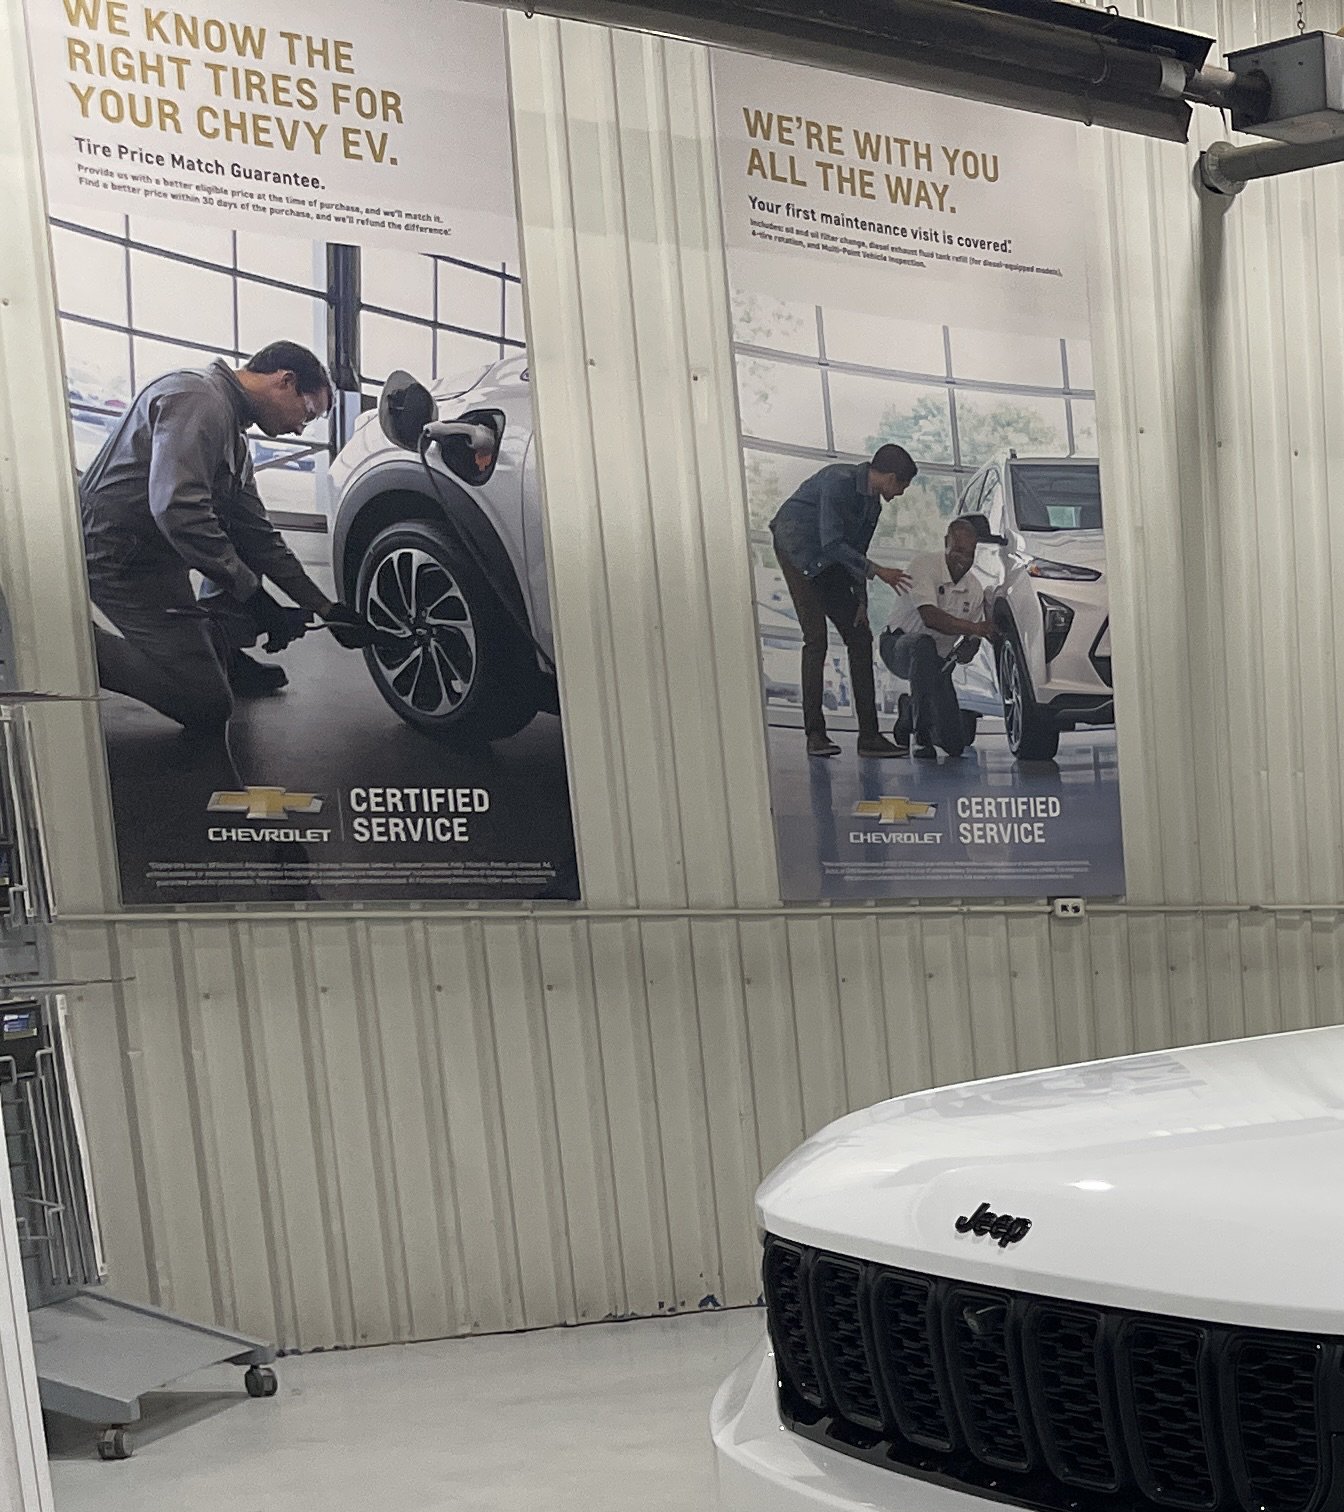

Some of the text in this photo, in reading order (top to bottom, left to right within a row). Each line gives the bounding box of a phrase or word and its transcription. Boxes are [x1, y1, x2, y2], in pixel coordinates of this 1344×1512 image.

[62, 0, 355, 74] WE KNOW THE
[67, 37, 404, 124] RIGHT TIRES FOR
[68, 81, 398, 166] YOUR CHEVY EV.
[742, 106, 1000, 183] WE'RE WITH YOU
[74, 136, 326, 190] Tire Price Match Guarantee.
[746, 148, 957, 214] ALL THE WAY.
[749, 194, 782, 215] Your
[785, 203, 817, 222] first
[821, 212, 908, 238] maintenance
[910, 226, 940, 243] visit
[942, 229, 954, 245] is
[349, 786, 490, 813] CERTIFIED
[956, 796, 1061, 819] CERTIFIED
[207, 826, 331, 843] CHEVROLET
[352, 817, 469, 843] SERVICE
[849, 831, 943, 845] CHEVROLET
[959, 823, 1046, 845] SERVICE
[955, 1202, 1032, 1248] Jeep
